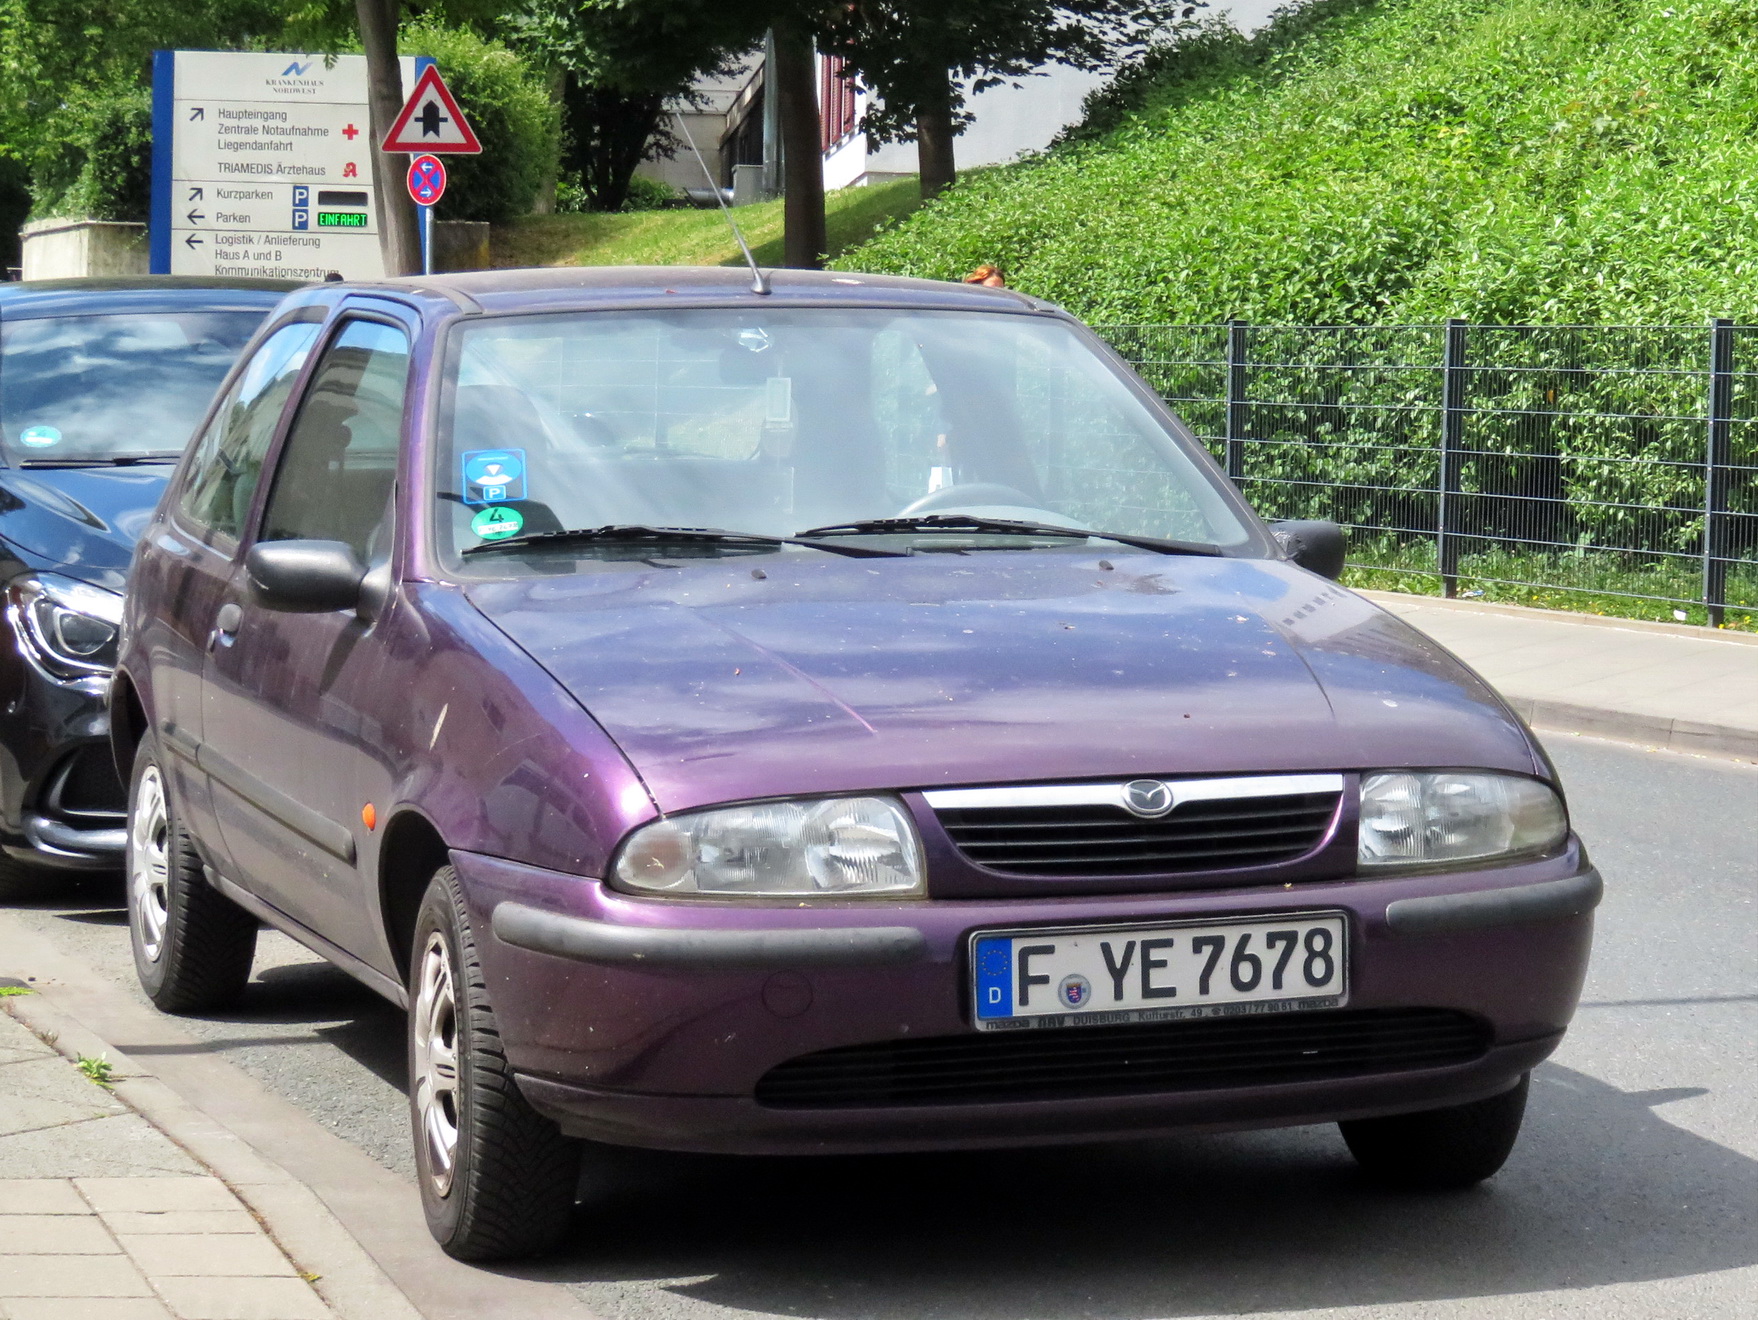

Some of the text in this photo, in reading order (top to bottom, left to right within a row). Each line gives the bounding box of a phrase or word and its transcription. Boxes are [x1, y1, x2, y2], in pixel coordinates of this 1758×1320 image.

[218, 108, 287, 123] Haupteingang
[218, 123, 329, 137] Zentrale Notaufnahme
[218, 139, 293, 153] Liegendanfahrt
[218, 161, 326, 176] TRIAMEDIS Ärztehaus
[216, 188, 273, 201] Kurzparken
[294, 188, 308, 205] P
[216, 212, 251, 223] Parken
[294, 211, 308, 227] P
[319, 213, 367, 226] EINFAHRT
[215, 234, 254, 247] Logistik
[263, 235, 321, 249] Anlieferung
[215, 249, 283, 261] Haus A und B
[490, 508, 504, 522] 4
[1018, 927, 1335, 1007] F YE 7678
[988, 987, 1001, 1004] D
[1073, 1013, 1131, 1026] DUISBURG
